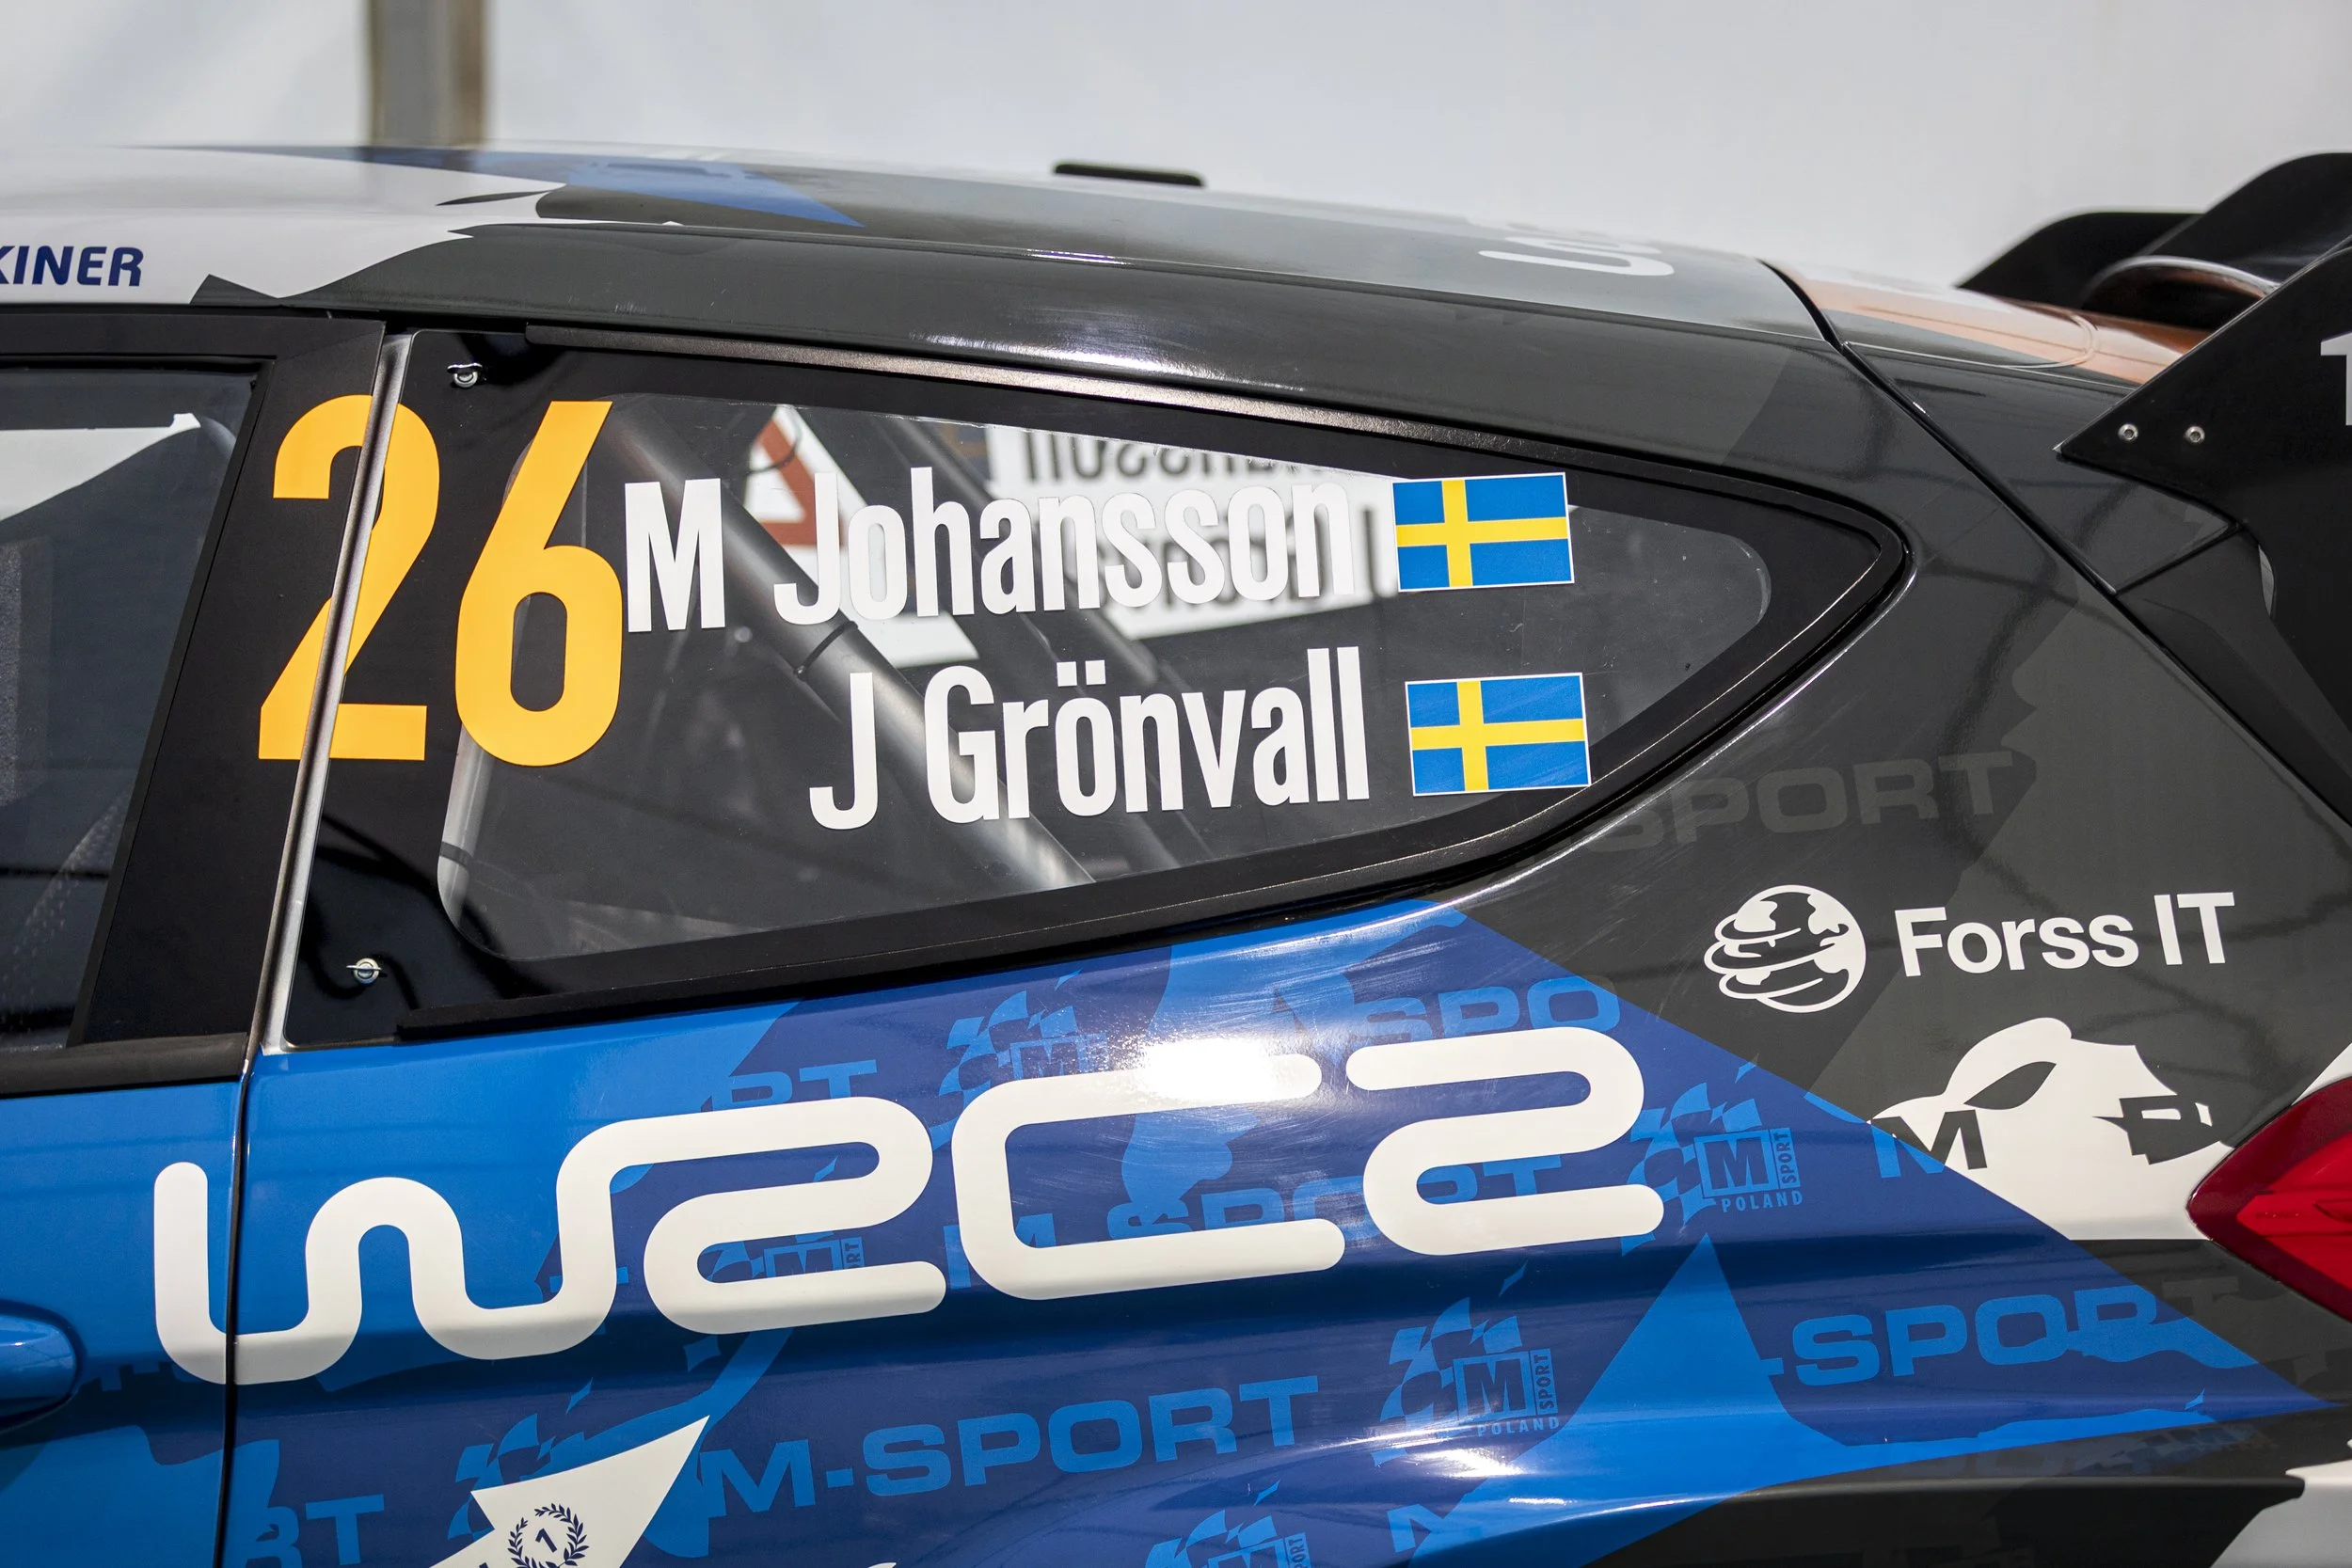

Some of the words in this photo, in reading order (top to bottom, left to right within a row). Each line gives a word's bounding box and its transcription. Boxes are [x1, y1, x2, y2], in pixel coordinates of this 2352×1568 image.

[258, 394, 622, 768] 26
[624, 479, 725, 633] M
[774, 467, 1355, 625] Johansson
[810, 672, 878, 830] J
[923, 646, 1370, 824] Grönvall
[1895, 907, 2140, 977] Forss
[2153, 892, 2236, 966] IT
[154, 1027, 1665, 1385] WRC2
[1722, 1190, 1803, 1212] POLAND
[1773, 1132, 1797, 1184] SPORT
[1477, 1416, 1561, 1437] POLAND
[1534, 1354, 1555, 1411] SPORT
[701, 1375, 1318, 1517] M-SPORT
